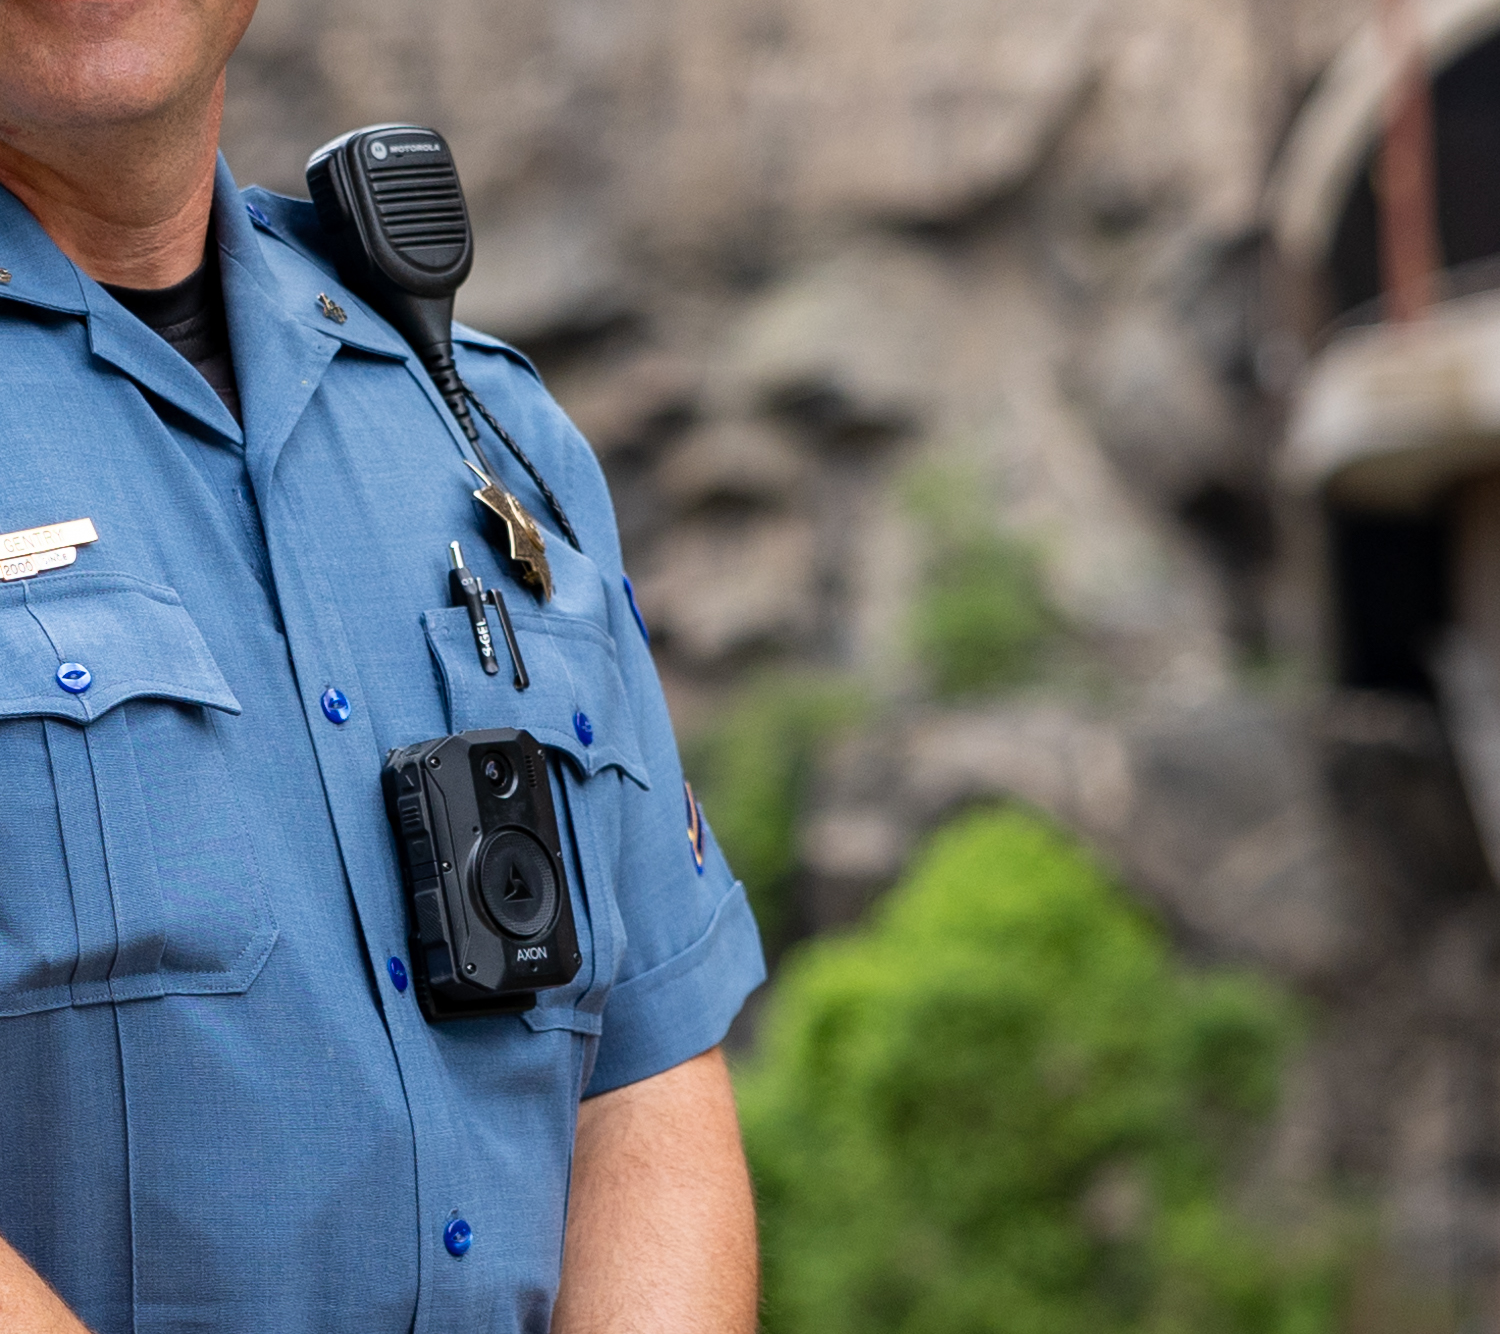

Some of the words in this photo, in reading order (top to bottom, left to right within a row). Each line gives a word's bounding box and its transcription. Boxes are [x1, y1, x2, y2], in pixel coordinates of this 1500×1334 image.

[389, 143, 440, 154] MOTOROLA
[3, 529, 63, 553] GENTRY
[3, 560, 34, 577] 2000
[516, 946, 548, 962] AXON
